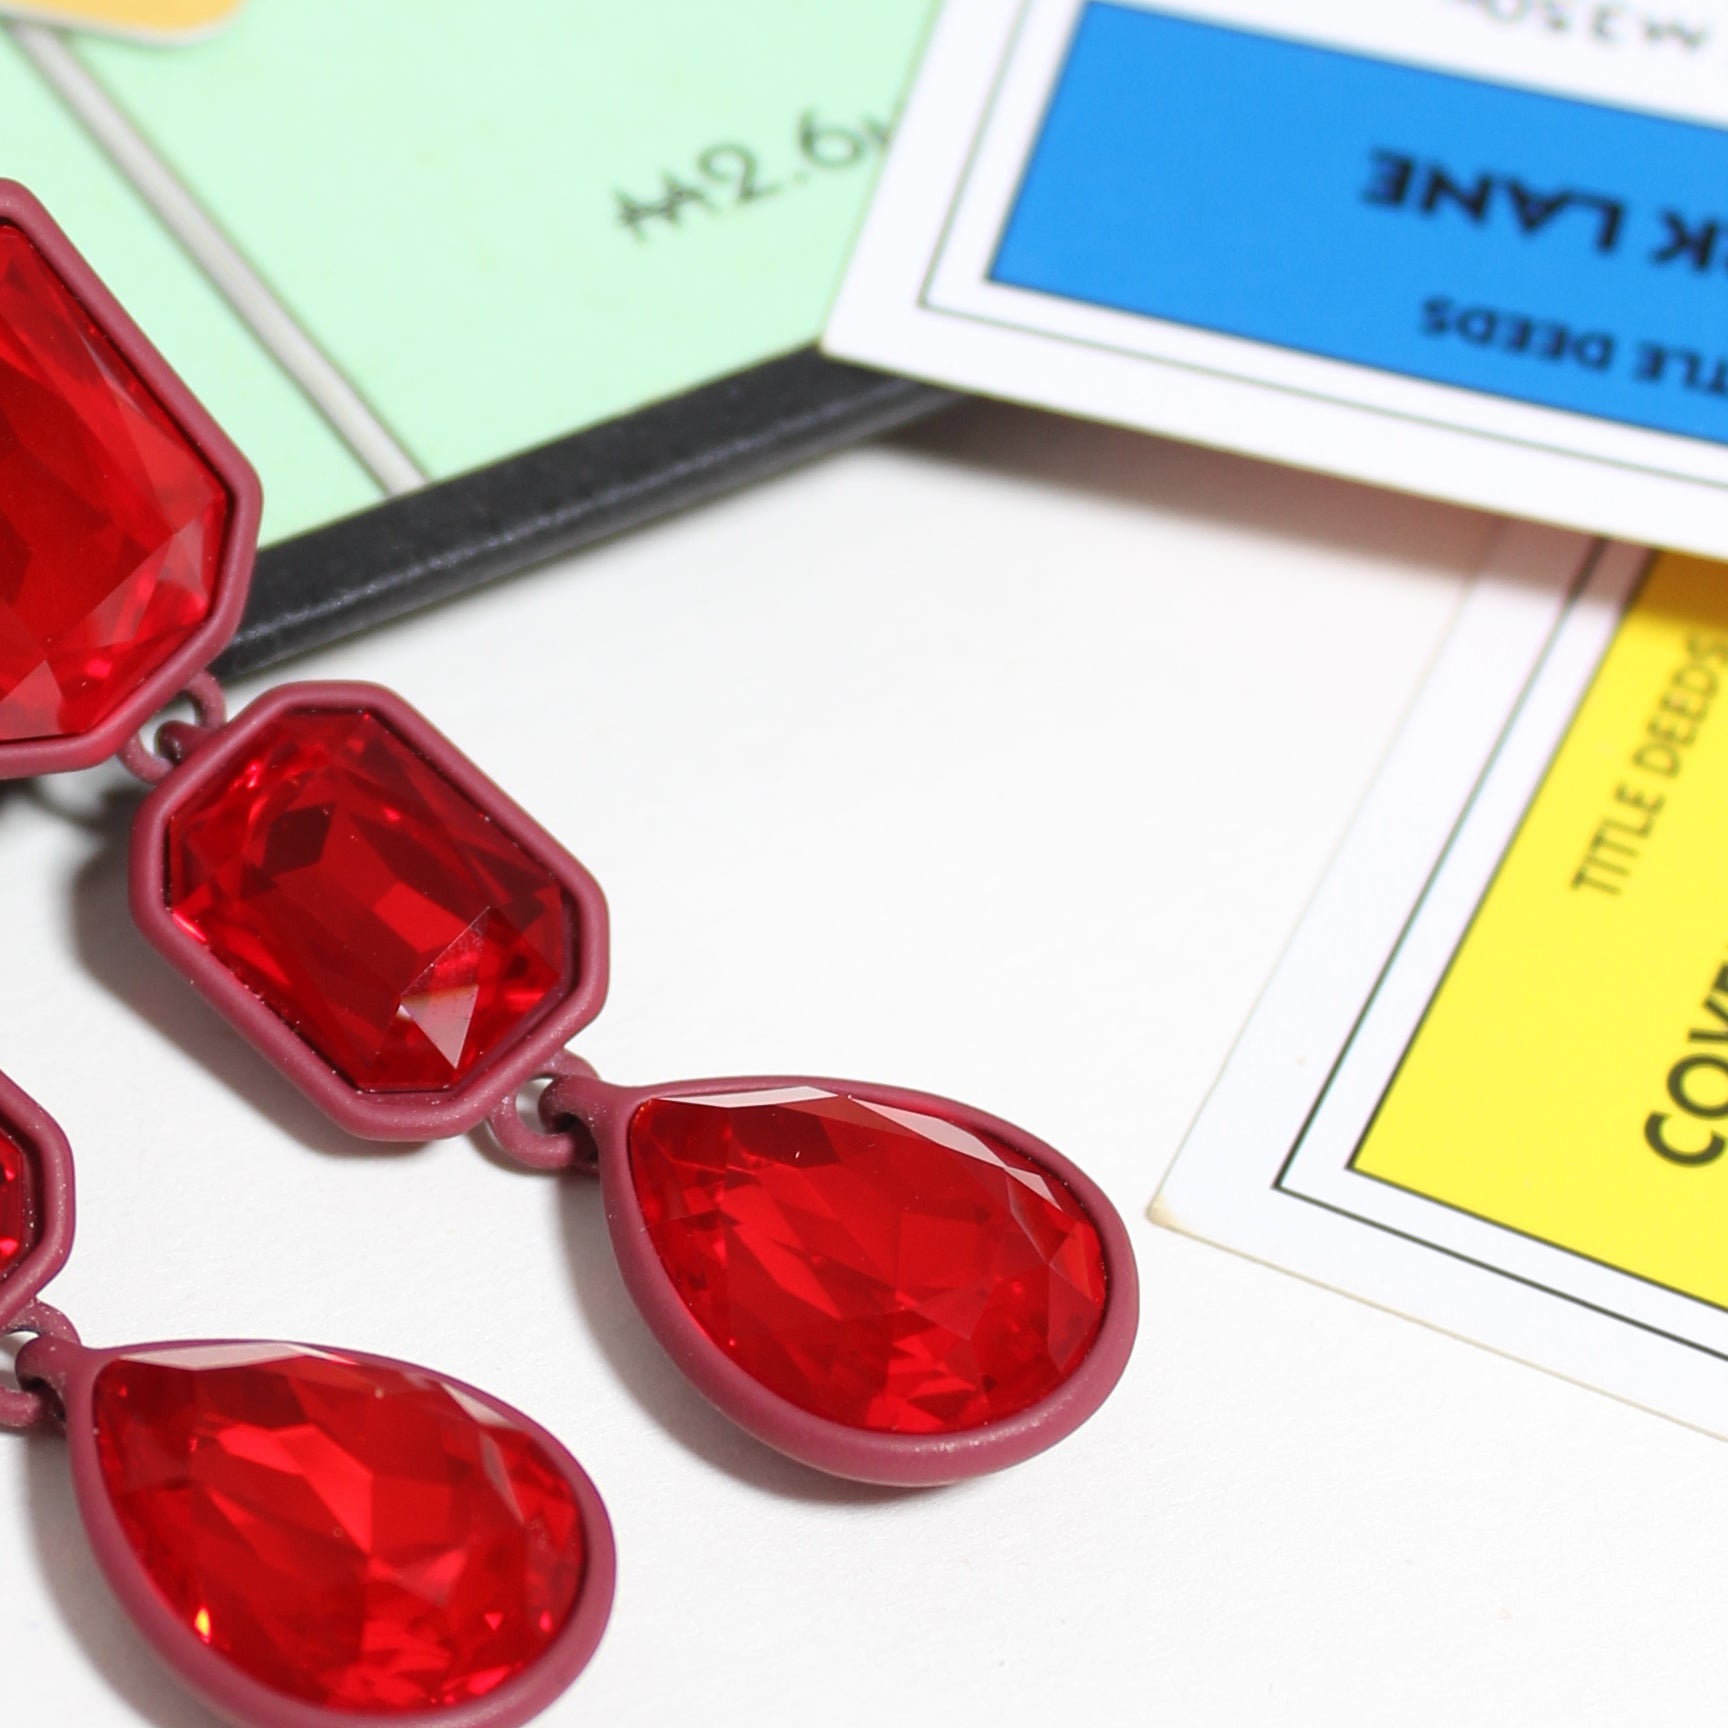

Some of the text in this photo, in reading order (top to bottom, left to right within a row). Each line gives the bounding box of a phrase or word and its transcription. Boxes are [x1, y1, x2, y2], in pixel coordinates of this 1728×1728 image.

[1362, 146, 1628, 258] LANE
[1418, 298, 1617, 372] DEEDS
[1570, 780, 1668, 898] TITLE
